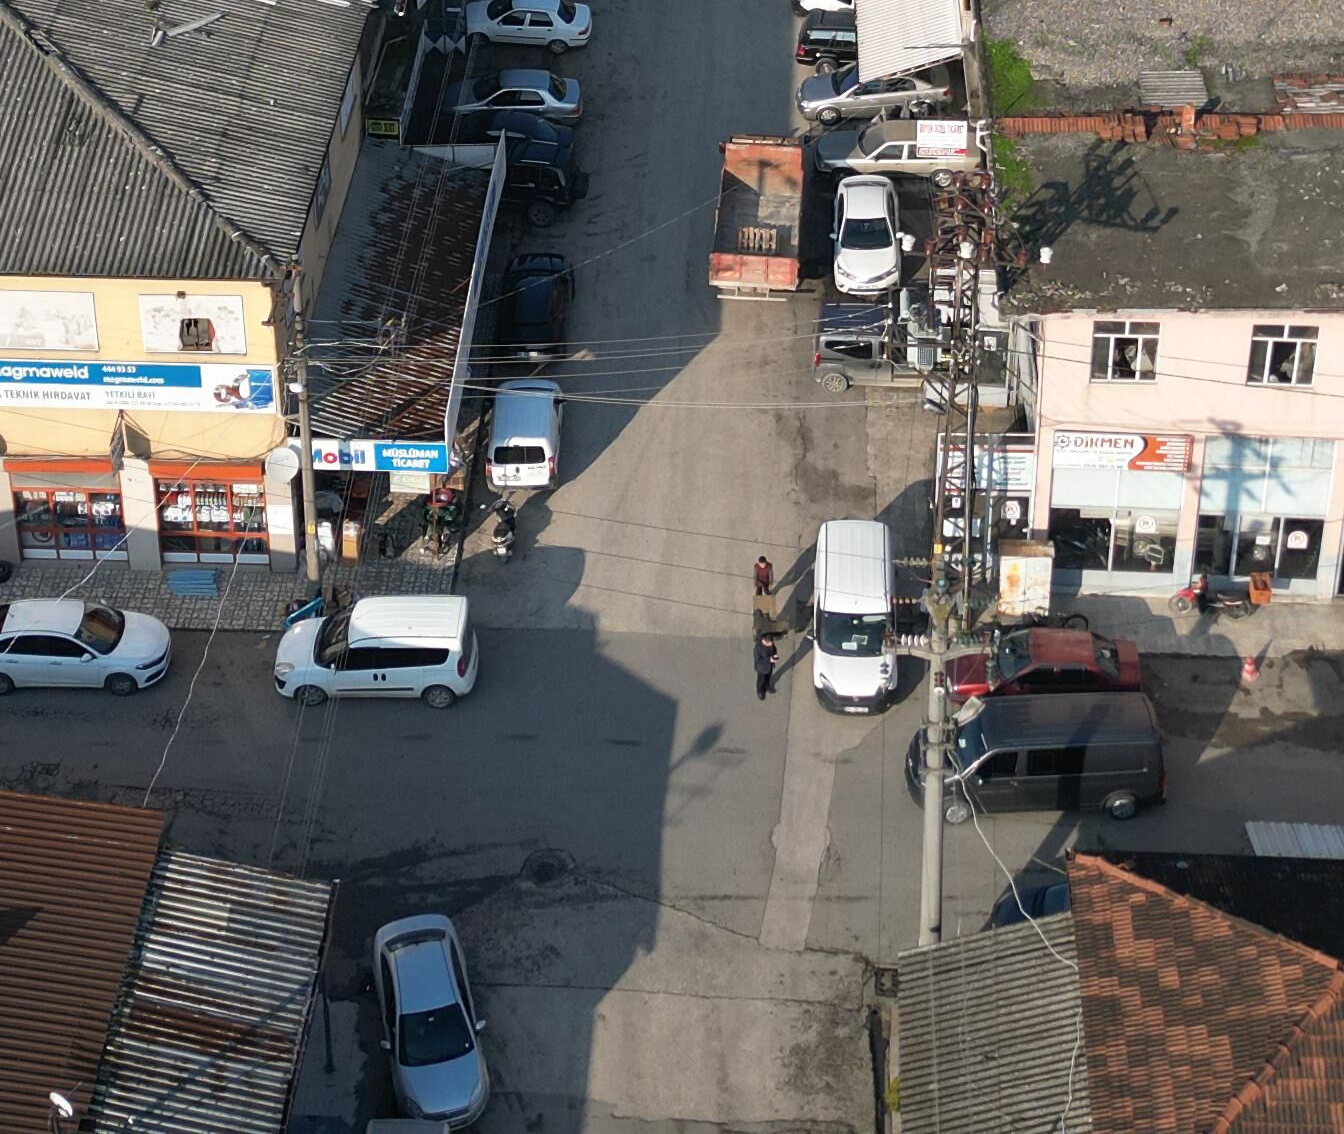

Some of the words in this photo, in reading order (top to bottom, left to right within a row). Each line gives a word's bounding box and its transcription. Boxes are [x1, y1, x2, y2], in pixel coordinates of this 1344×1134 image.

[101, 365, 116, 373] 444
[4, 388, 40, 400] TEKNİK
[42, 389, 91, 401] HIRDAVAT
[1074, 435, 1134, 449] DİKMEN
[382, 447, 439, 459] MÜSLÜMAN
[392, 458, 431, 469] TİCARET
